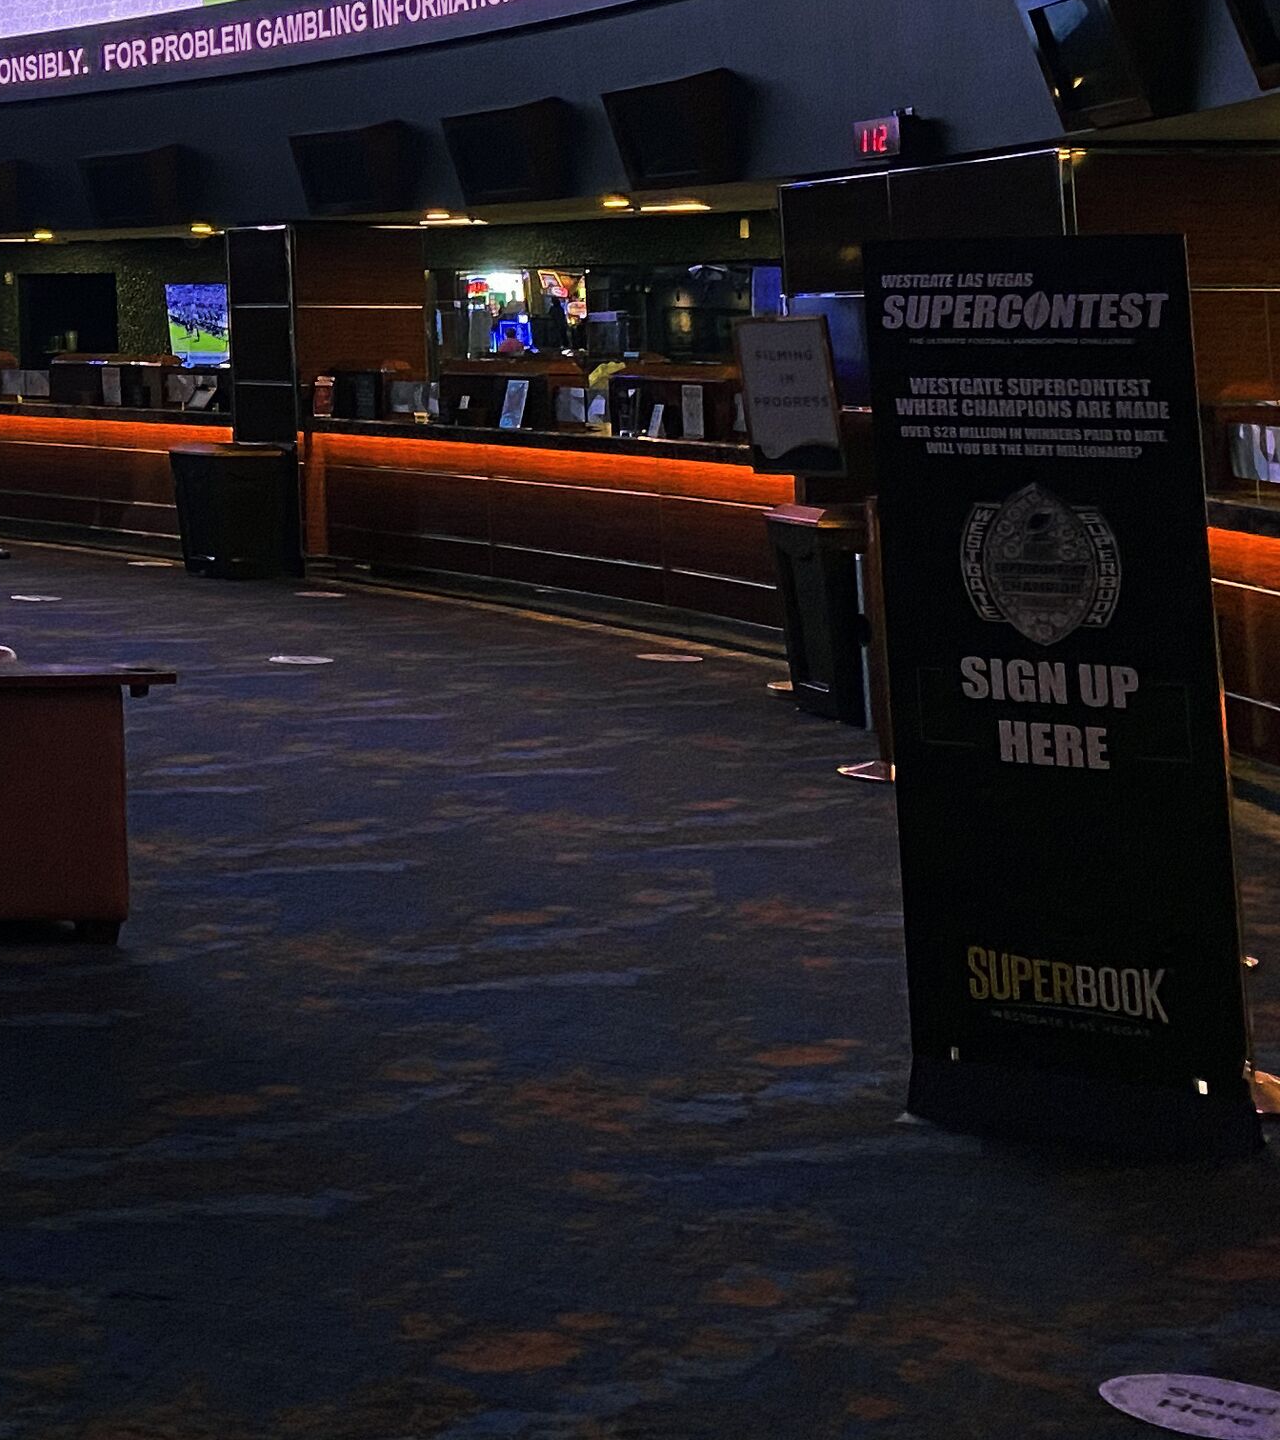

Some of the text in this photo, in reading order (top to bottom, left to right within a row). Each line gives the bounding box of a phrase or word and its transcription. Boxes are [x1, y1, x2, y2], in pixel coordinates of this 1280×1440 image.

[103, 42, 147, 71] FOR
[151, 22, 252, 64] PROBLEM
[256, 2, 367, 49] GAMBLING
[881, 273, 1033, 288] WESTGATE LAS VEGAS
[754, 351, 813, 360] FILMING
[910, 377, 1151, 397] WESTGATE SUPERCONTEST
[754, 396, 829, 407] PROGRESS
[895, 398, 1170, 419] WHERE CHAMPIONS ARE MADE
[1114, 429, 1131, 441] TO
[956, 442, 980, 455] YOU
[1000, 443, 1023, 456] THE
[960, 656, 1139, 709] SIGN UP
[999, 719, 1110, 770] HERE
[967, 945, 1169, 1024] SUPERBOOK
[1158, 1399, 1255, 1426] Here
